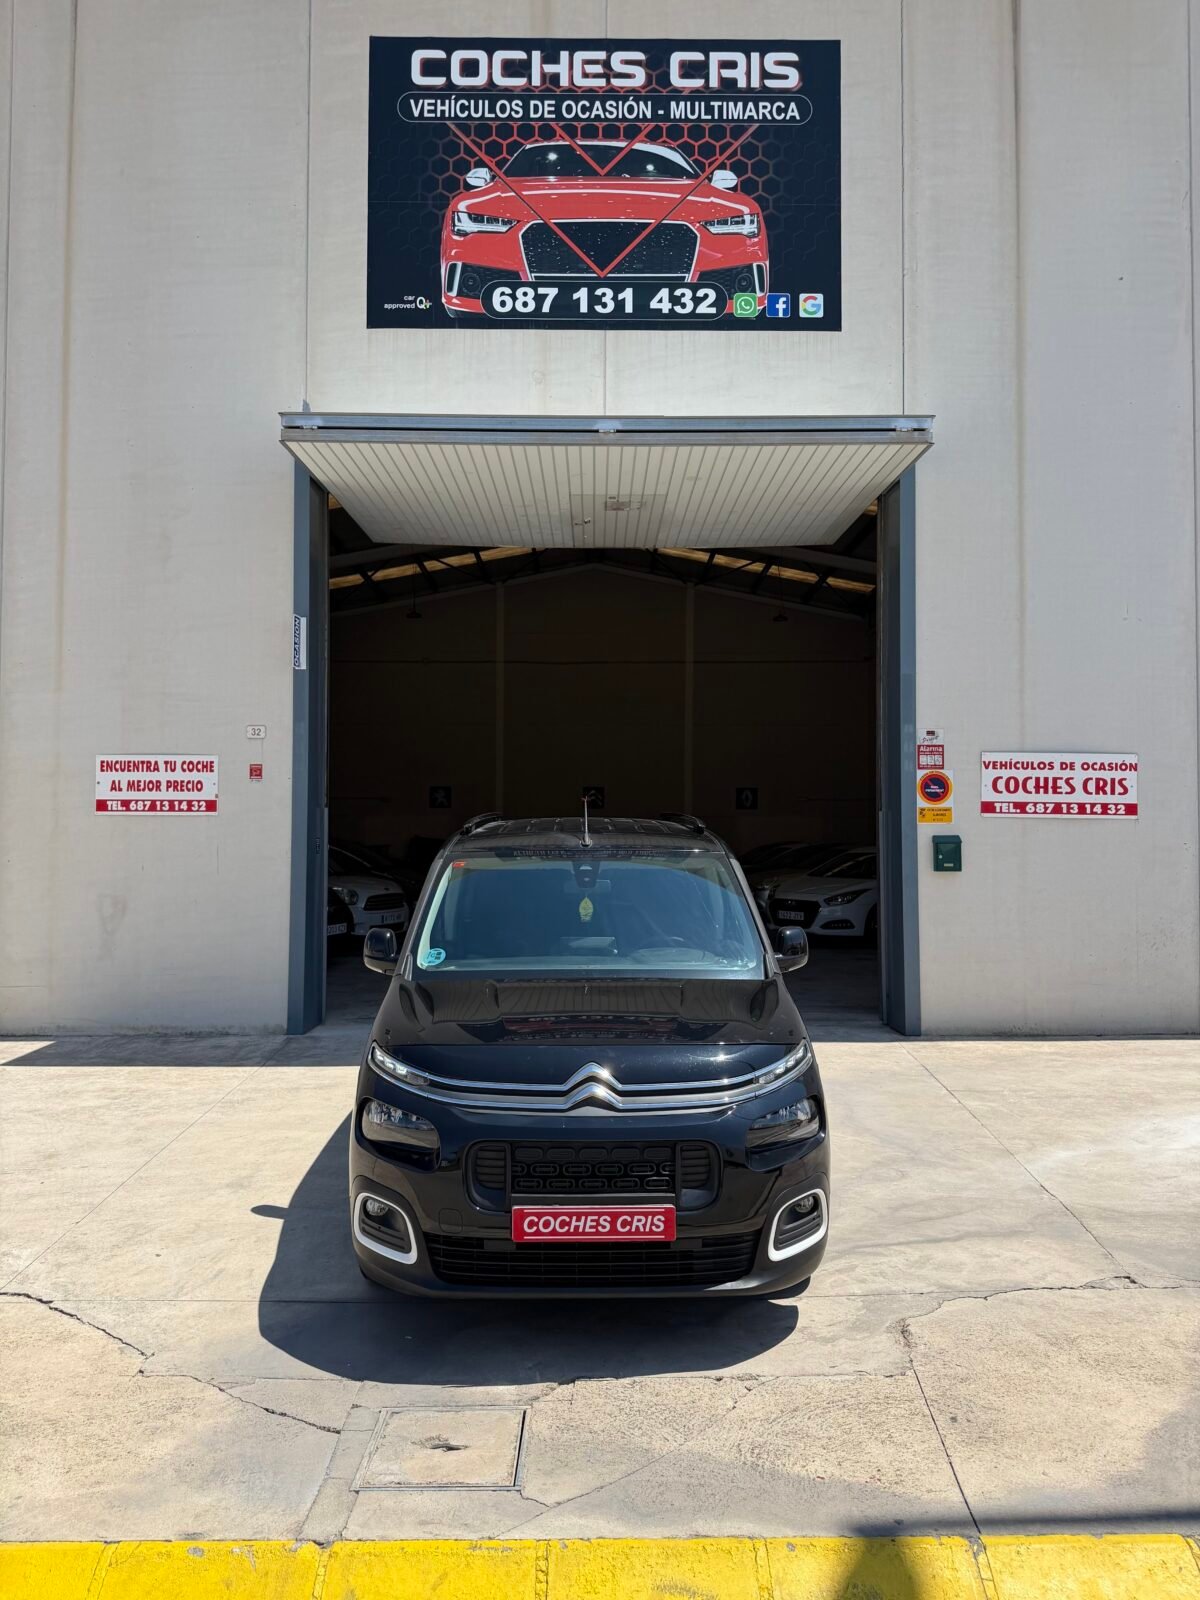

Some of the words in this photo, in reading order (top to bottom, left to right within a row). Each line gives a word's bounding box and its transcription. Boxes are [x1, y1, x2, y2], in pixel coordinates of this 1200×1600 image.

[411, 49, 646, 87] COCHES
[669, 51, 801, 88] CRIS
[410, 95, 523, 118] VEHÍCULOS
[529, 100, 556, 118] DE
[561, 96, 652, 119] OCASIÓN
[670, 101, 800, 120] MULTIMARCA
[384, 302, 416, 310] approved
[491, 287, 559, 313] 687
[572, 287, 633, 313] 131
[649, 288, 717, 314] 432
[251, 728, 262, 736] 32
[100, 760, 160, 773] ENCUENTRA
[164, 760, 177, 773] TU
[181, 760, 215, 773] COCHE
[983, 758, 1055, 770] VEHÍCULOS
[1060, 762, 1076, 771] DE
[1081, 760, 1138, 772] OCASIÓN
[110, 780, 123, 792] AL
[126, 780, 162, 792] MEJOR
[166, 780, 204, 792] PRECIO
[991, 776, 1076, 795] COCHES
[1082, 777, 1129, 796] CRIS
[106, 801, 126, 811] TEL.
[129, 801, 151, 811] 687
[155, 801, 169, 811] 13
[174, 801, 188, 811] 14
[191, 801, 206, 811] 32
[994, 802, 1020, 813] TEL.
[1025, 803, 1055, 813] 687
[1061, 803, 1079, 813] 13
[1085, 804, 1102, 814] 14
[1107, 804, 1126, 815] 32
[523, 1215, 611, 1233] COCHES
[616, 1215, 665, 1232] CRIS
